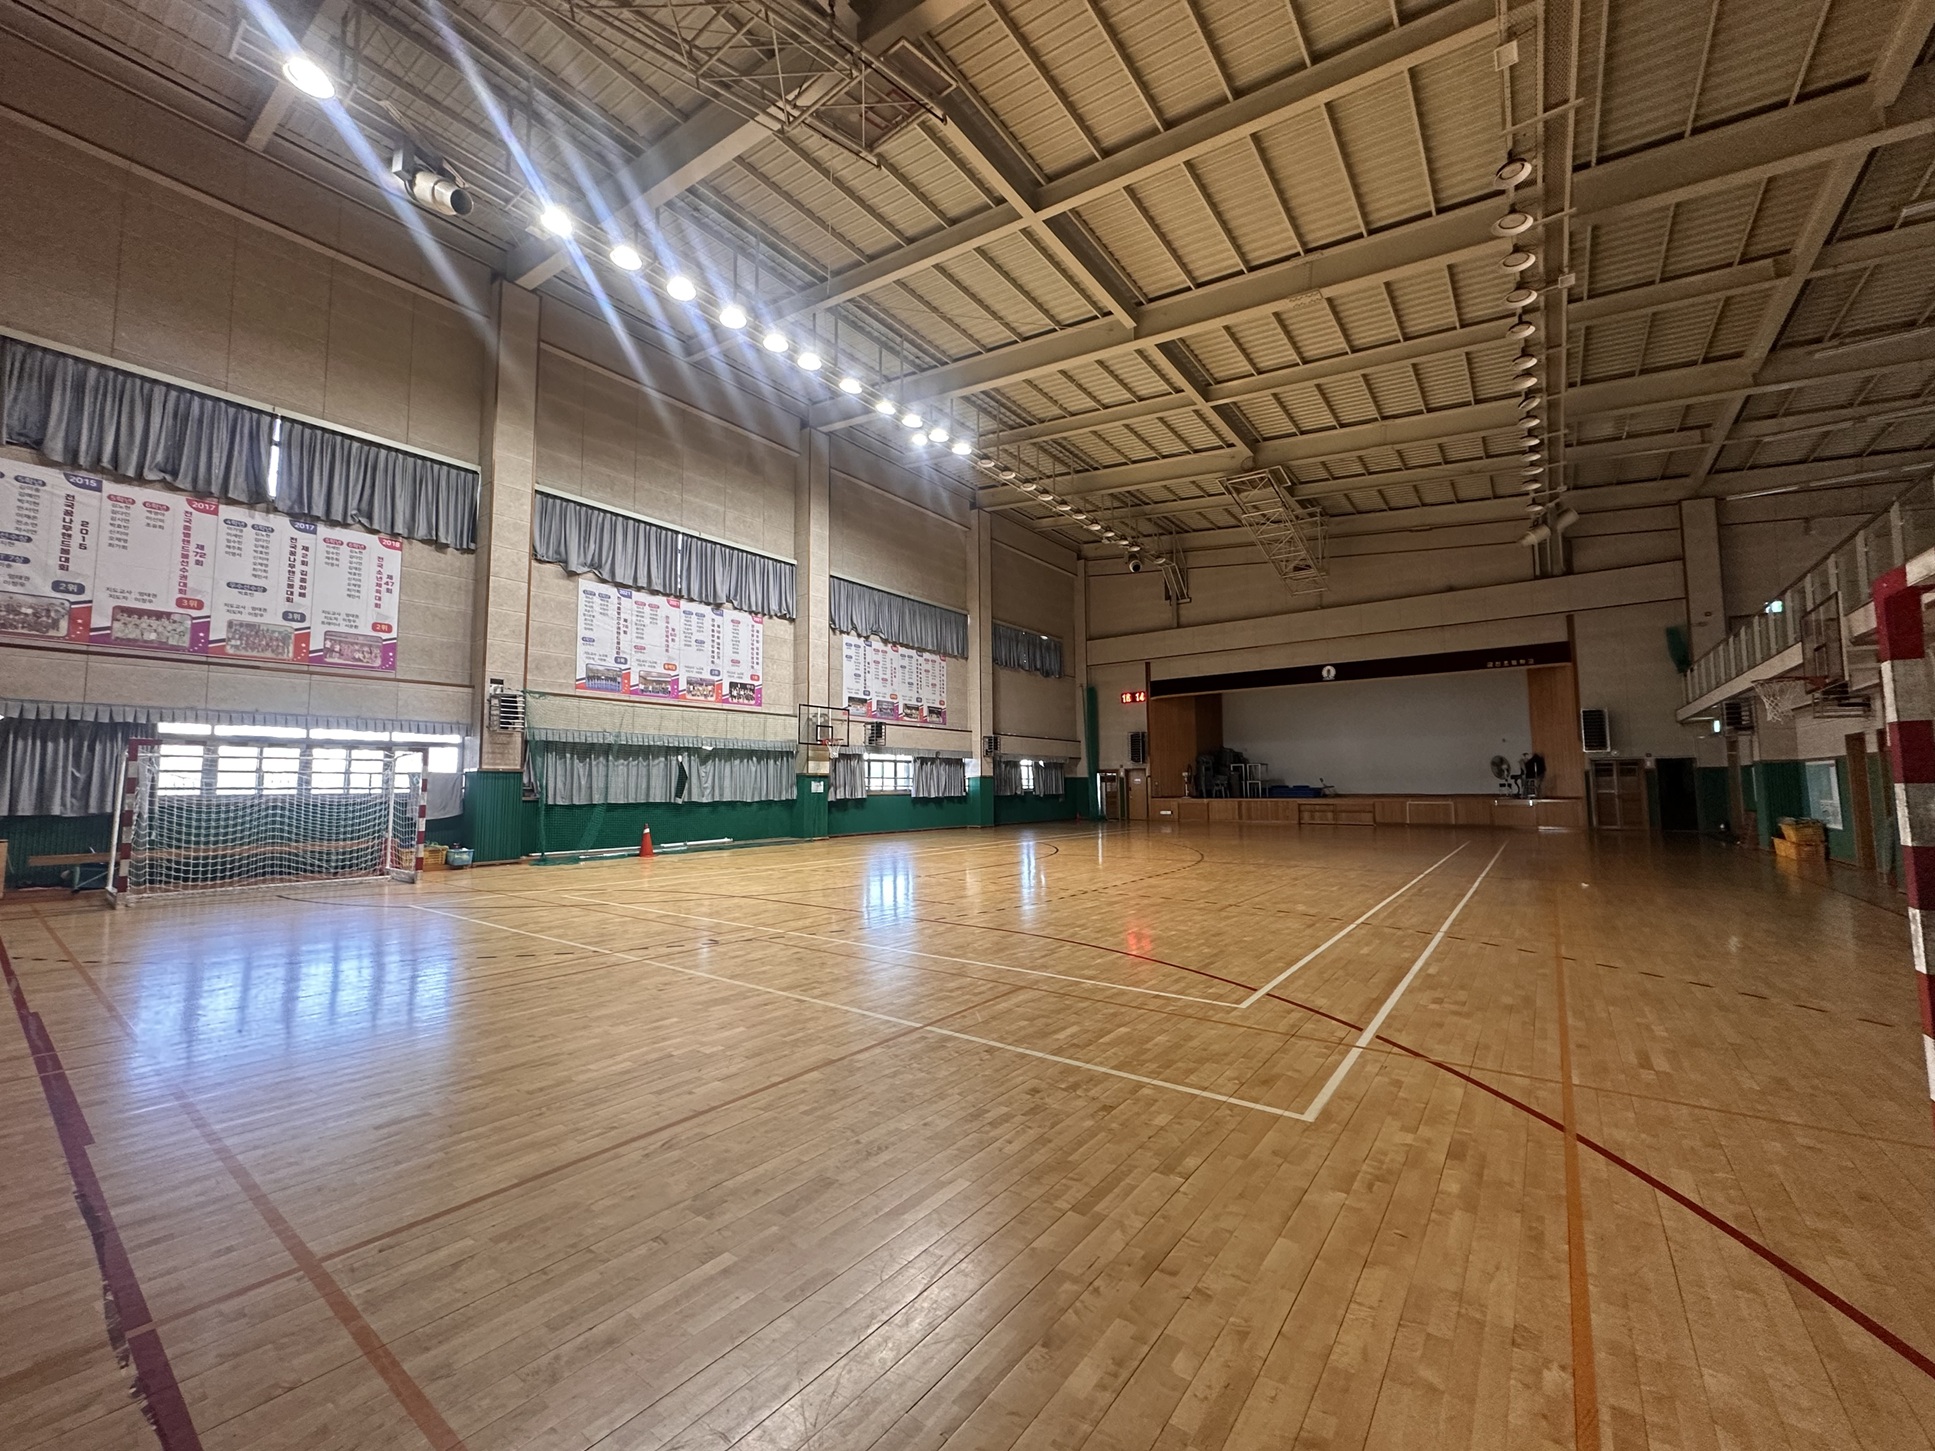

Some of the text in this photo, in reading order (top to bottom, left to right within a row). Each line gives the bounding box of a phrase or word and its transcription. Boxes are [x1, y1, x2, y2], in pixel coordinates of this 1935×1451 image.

[69, 475, 97, 487] 2015
[192, 501, 216, 511] 2017
[294, 522, 315, 531] 2017
[78, 520, 90, 550] 2015
[382, 539, 400, 548] 2018
[59, 582, 78, 593] 2위
[182, 599, 198, 608] 3위
